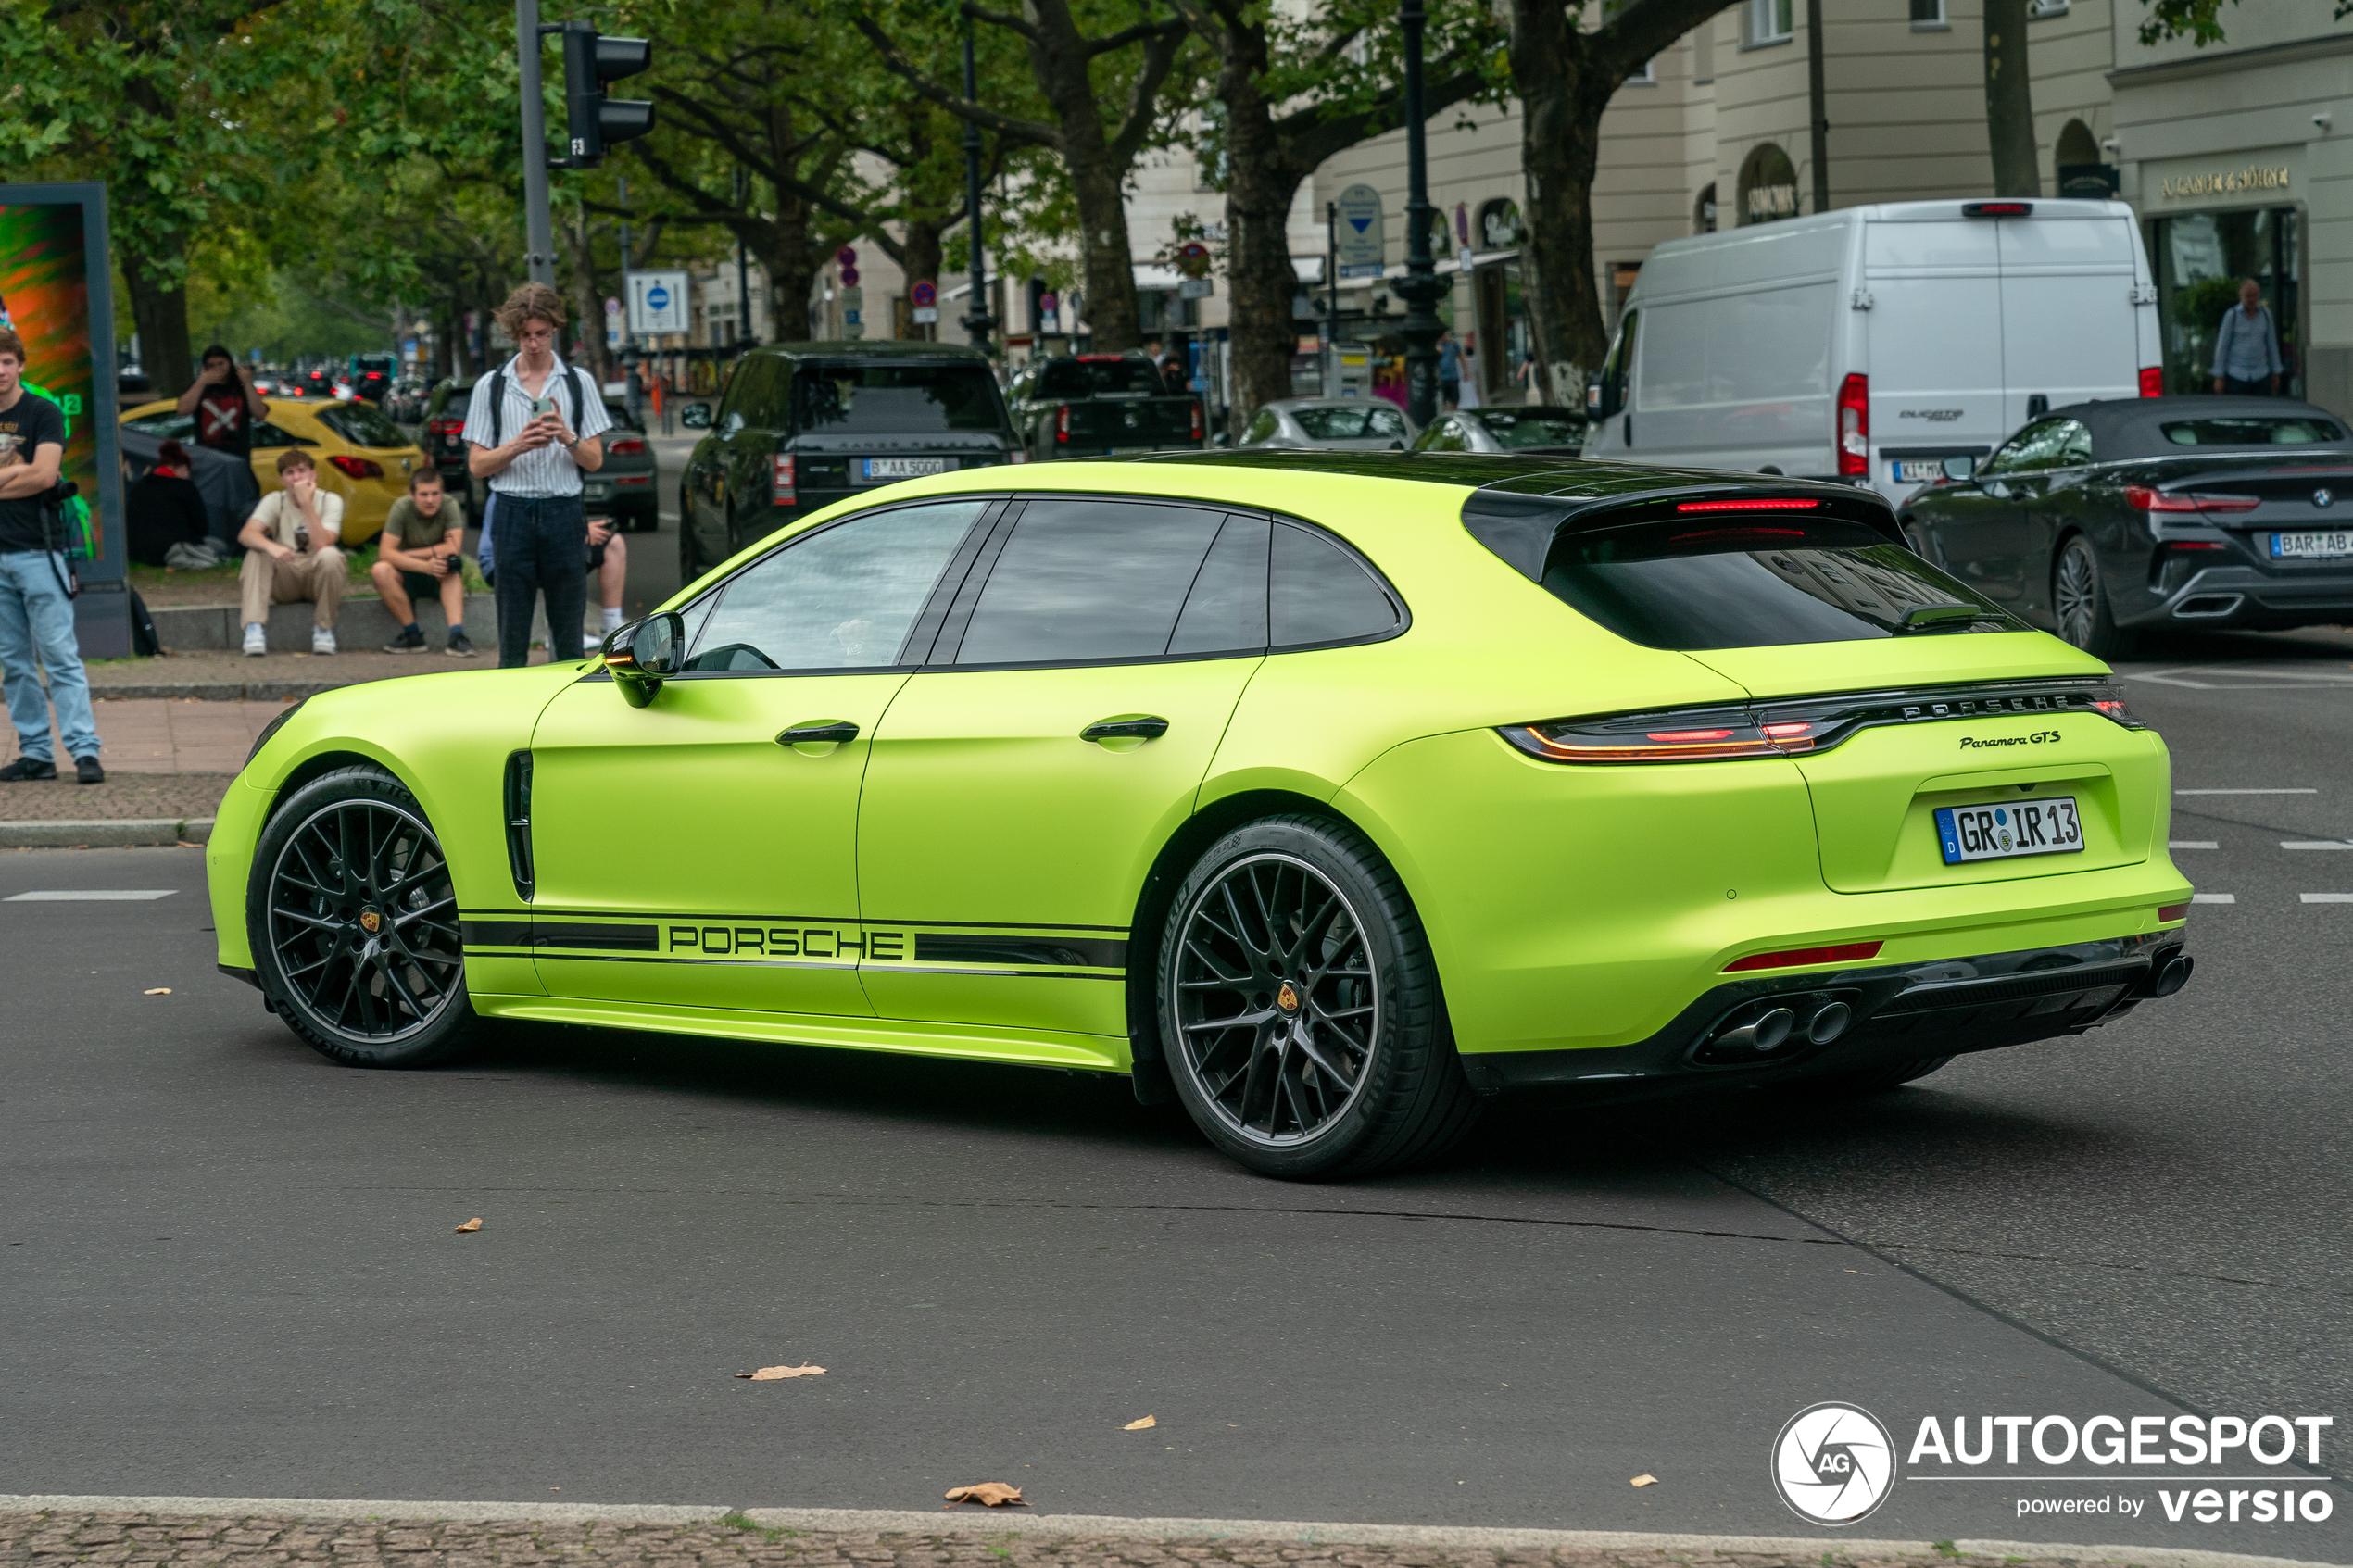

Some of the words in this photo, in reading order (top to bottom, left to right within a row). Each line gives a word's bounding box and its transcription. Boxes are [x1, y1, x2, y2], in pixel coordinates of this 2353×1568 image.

[571, 138, 585, 156] F3
[890, 462, 907, 475] AA
[2283, 536, 2314, 552] BAR
[2327, 534, 2347, 550] AB
[1902, 696, 2069, 721] PORSCHE
[1959, 736, 2028, 749] Panamera
[2029, 730, 2061, 744] GTS
[1947, 841, 1956, 853] D
[1958, 810, 1999, 853] GR
[2012, 806, 2046, 848] IR
[2046, 803, 2079, 844] 13
[668, 926, 904, 960] PORSCHE
